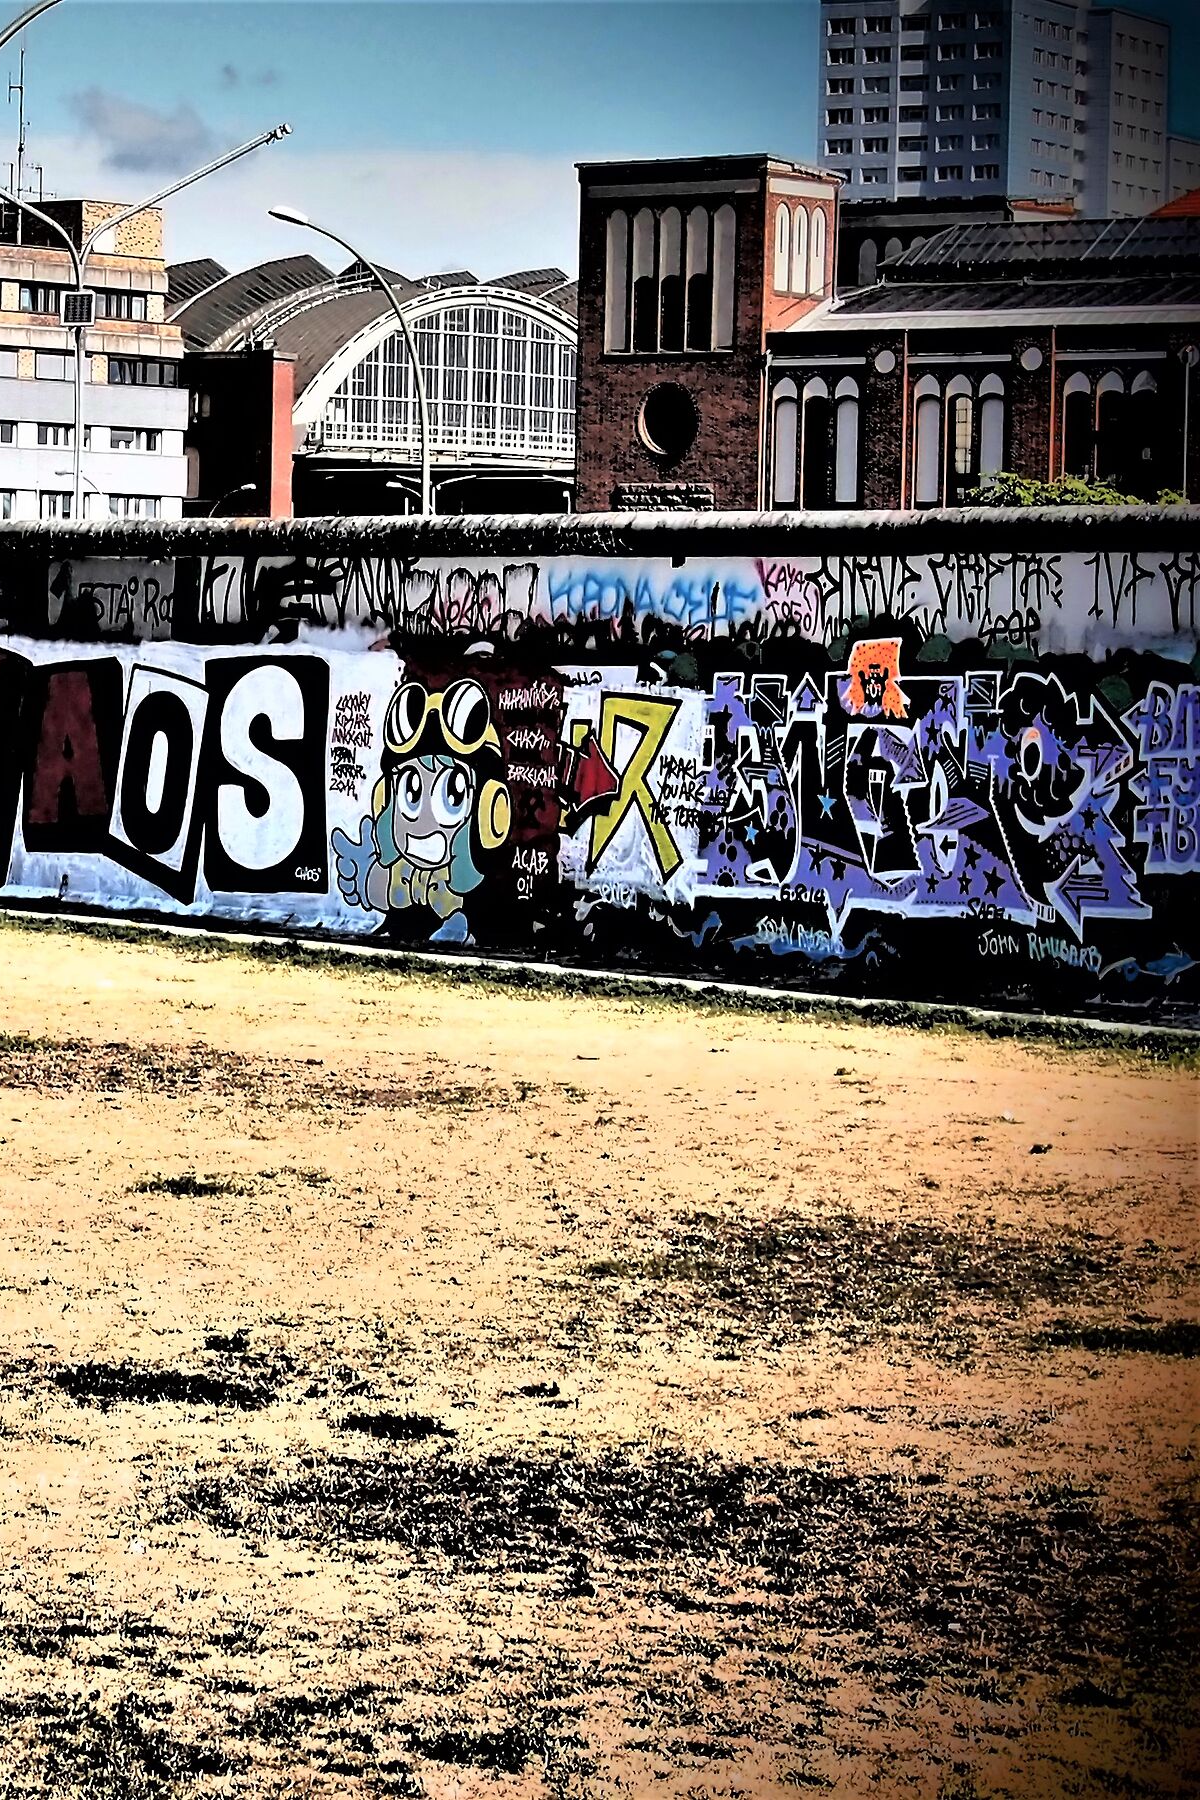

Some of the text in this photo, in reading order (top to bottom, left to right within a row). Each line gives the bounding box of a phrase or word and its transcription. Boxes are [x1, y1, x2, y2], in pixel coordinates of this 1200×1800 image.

[656, 781, 678, 804] YOU
[679, 776, 706, 805] ARE
[648, 803, 671, 826] THE
[978, 928, 1103, 976] JOHN RHUBARB
